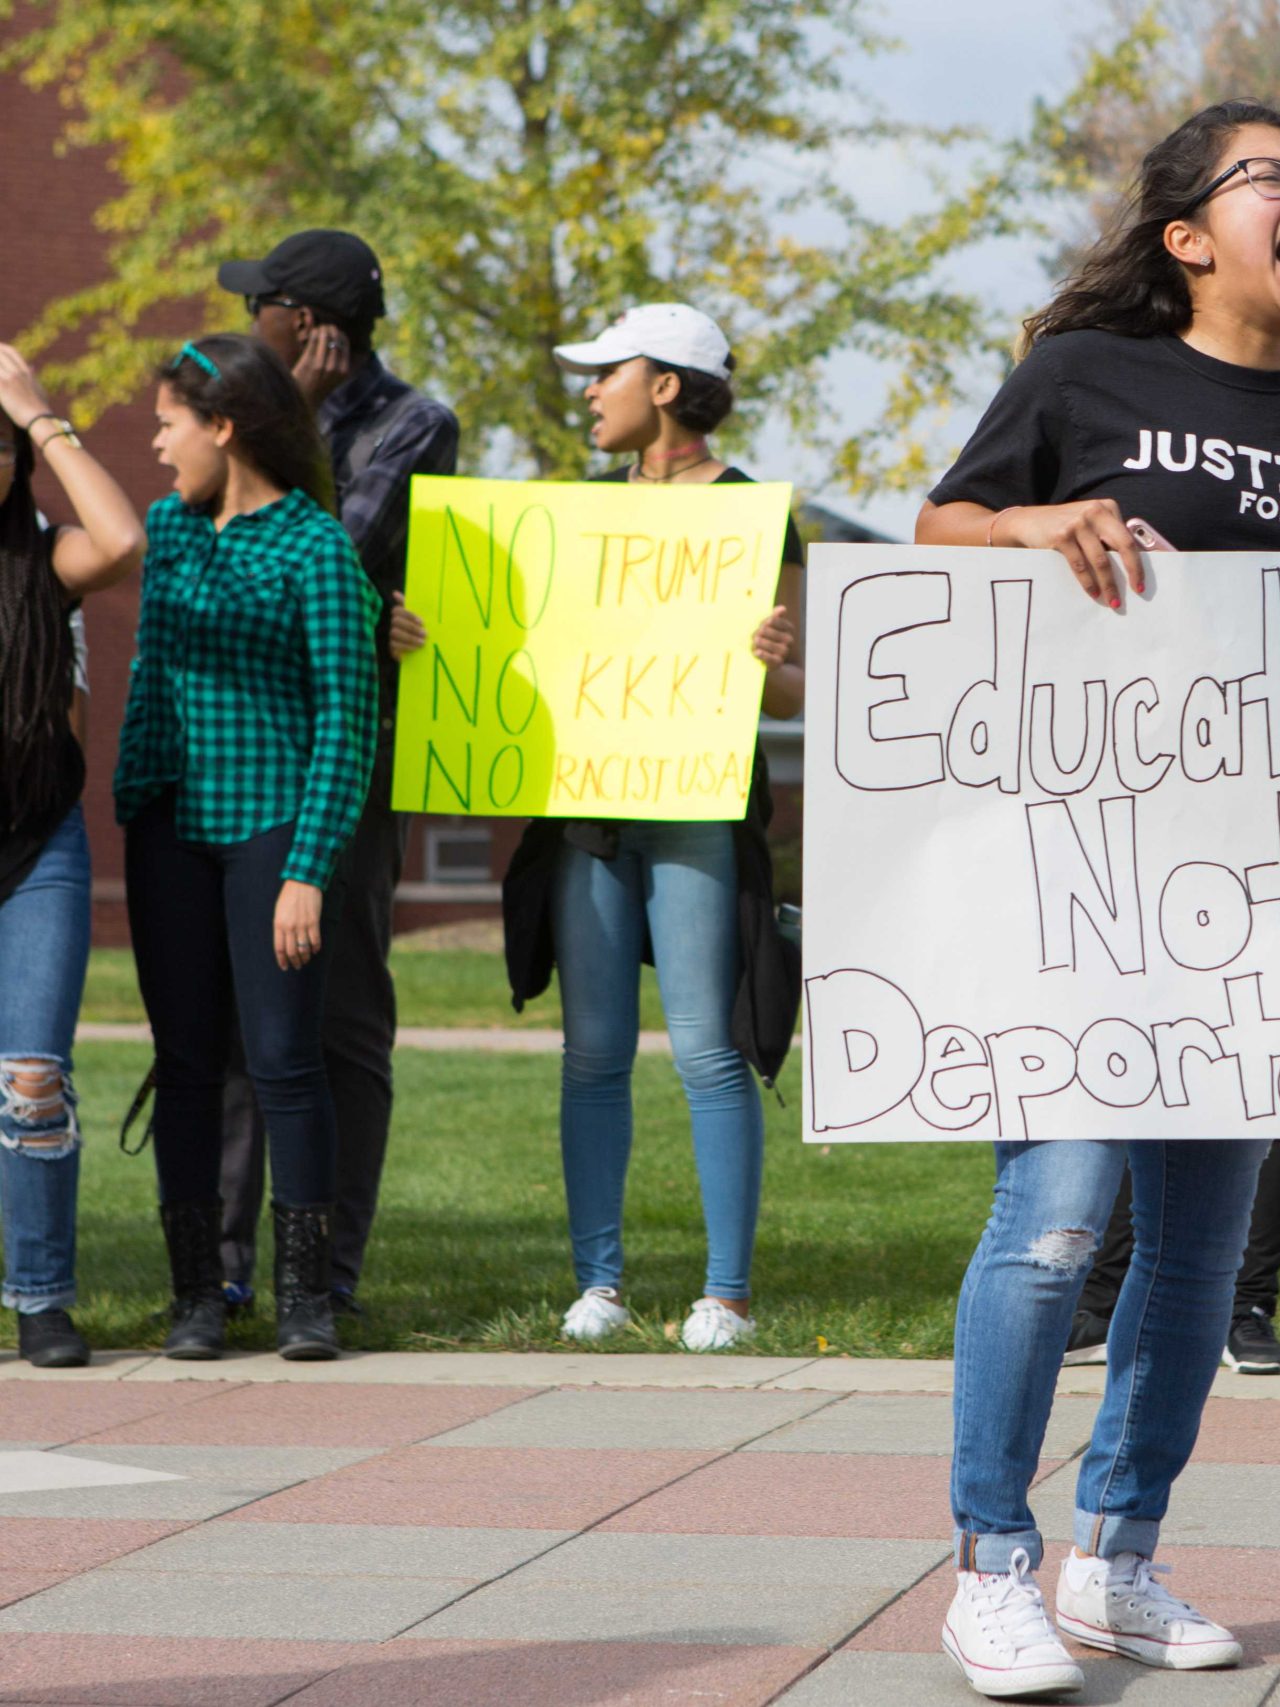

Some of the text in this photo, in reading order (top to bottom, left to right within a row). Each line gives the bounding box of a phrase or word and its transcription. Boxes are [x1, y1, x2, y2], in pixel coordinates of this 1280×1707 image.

[438, 504, 763, 630] NO TRUMP!
[430, 643, 539, 736] NO
[423, 740, 751, 812] NO RACIST USA!
